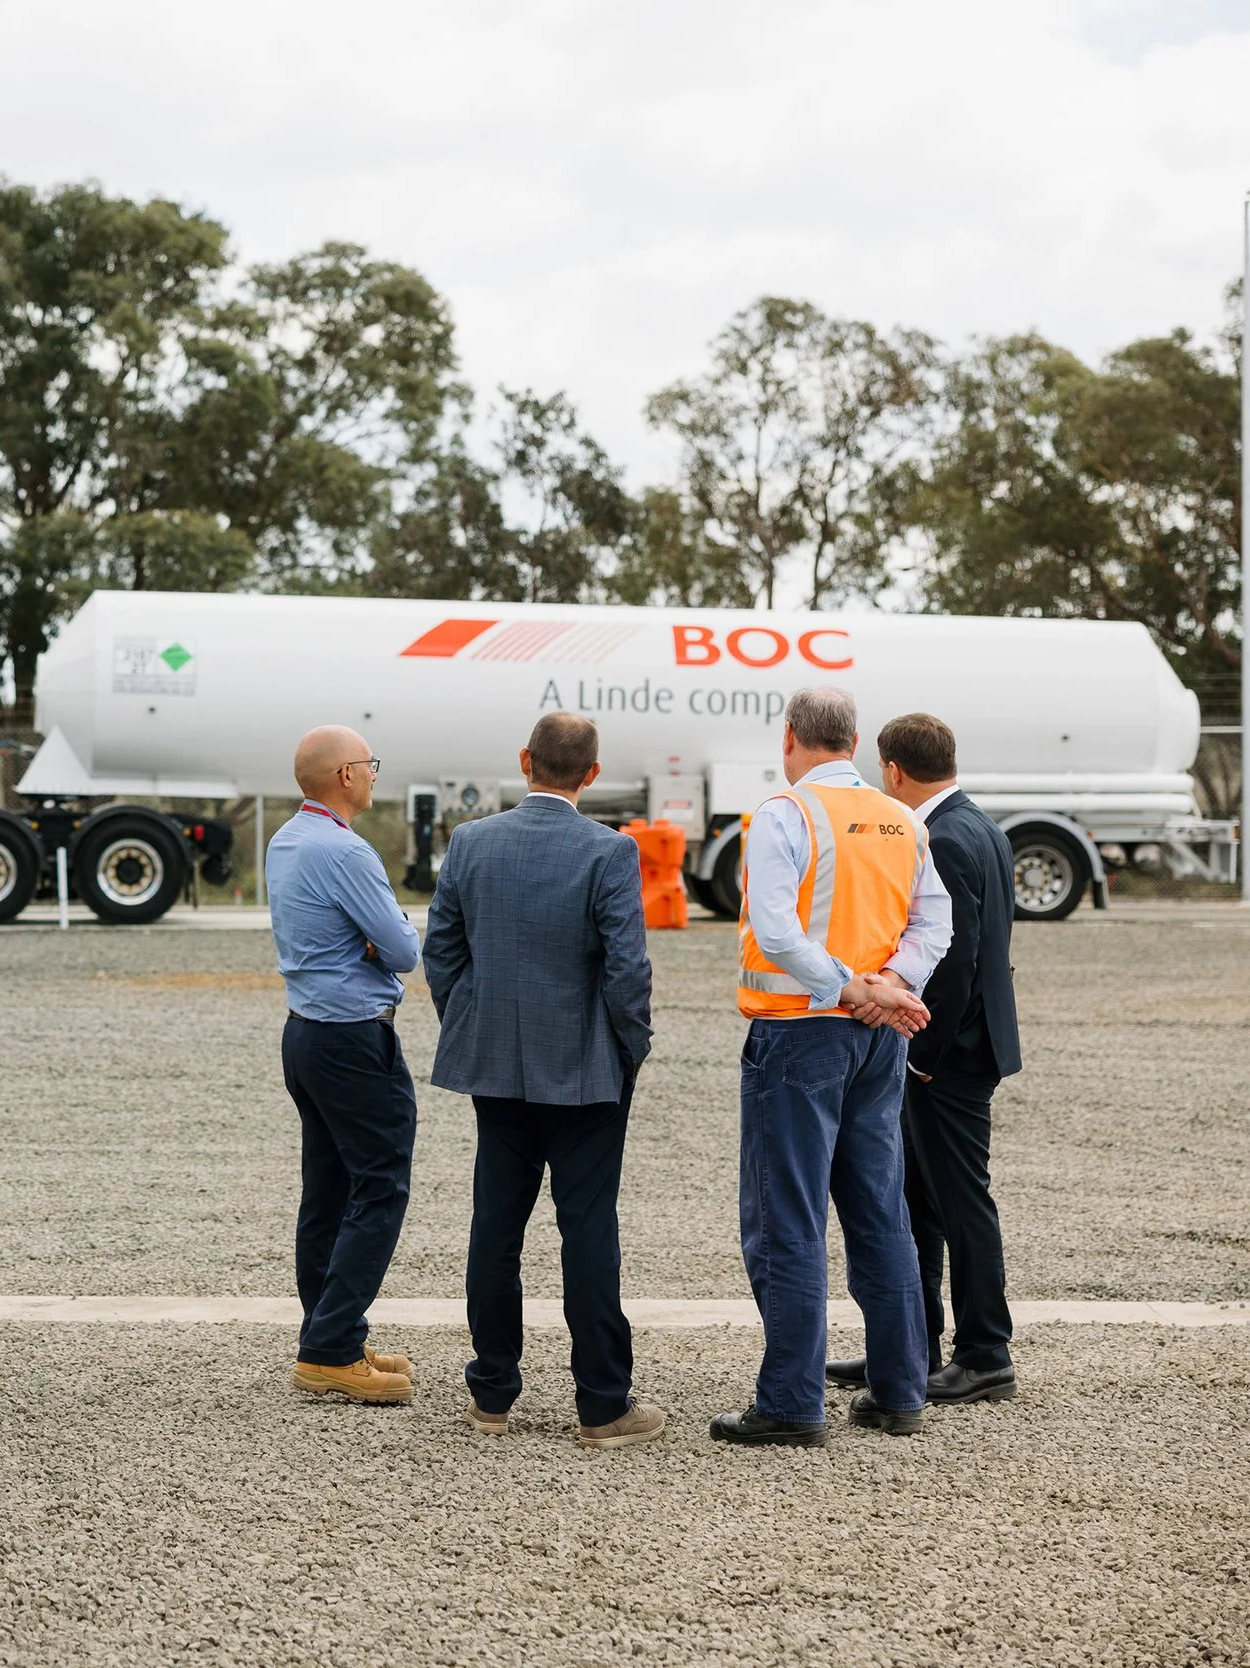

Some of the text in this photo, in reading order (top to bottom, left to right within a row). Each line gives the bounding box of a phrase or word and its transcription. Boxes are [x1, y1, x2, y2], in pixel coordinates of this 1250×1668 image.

[672, 625, 854, 669] BOC
[539, 677, 786, 724] A Linde comp
[879, 824, 904, 835] BOC
